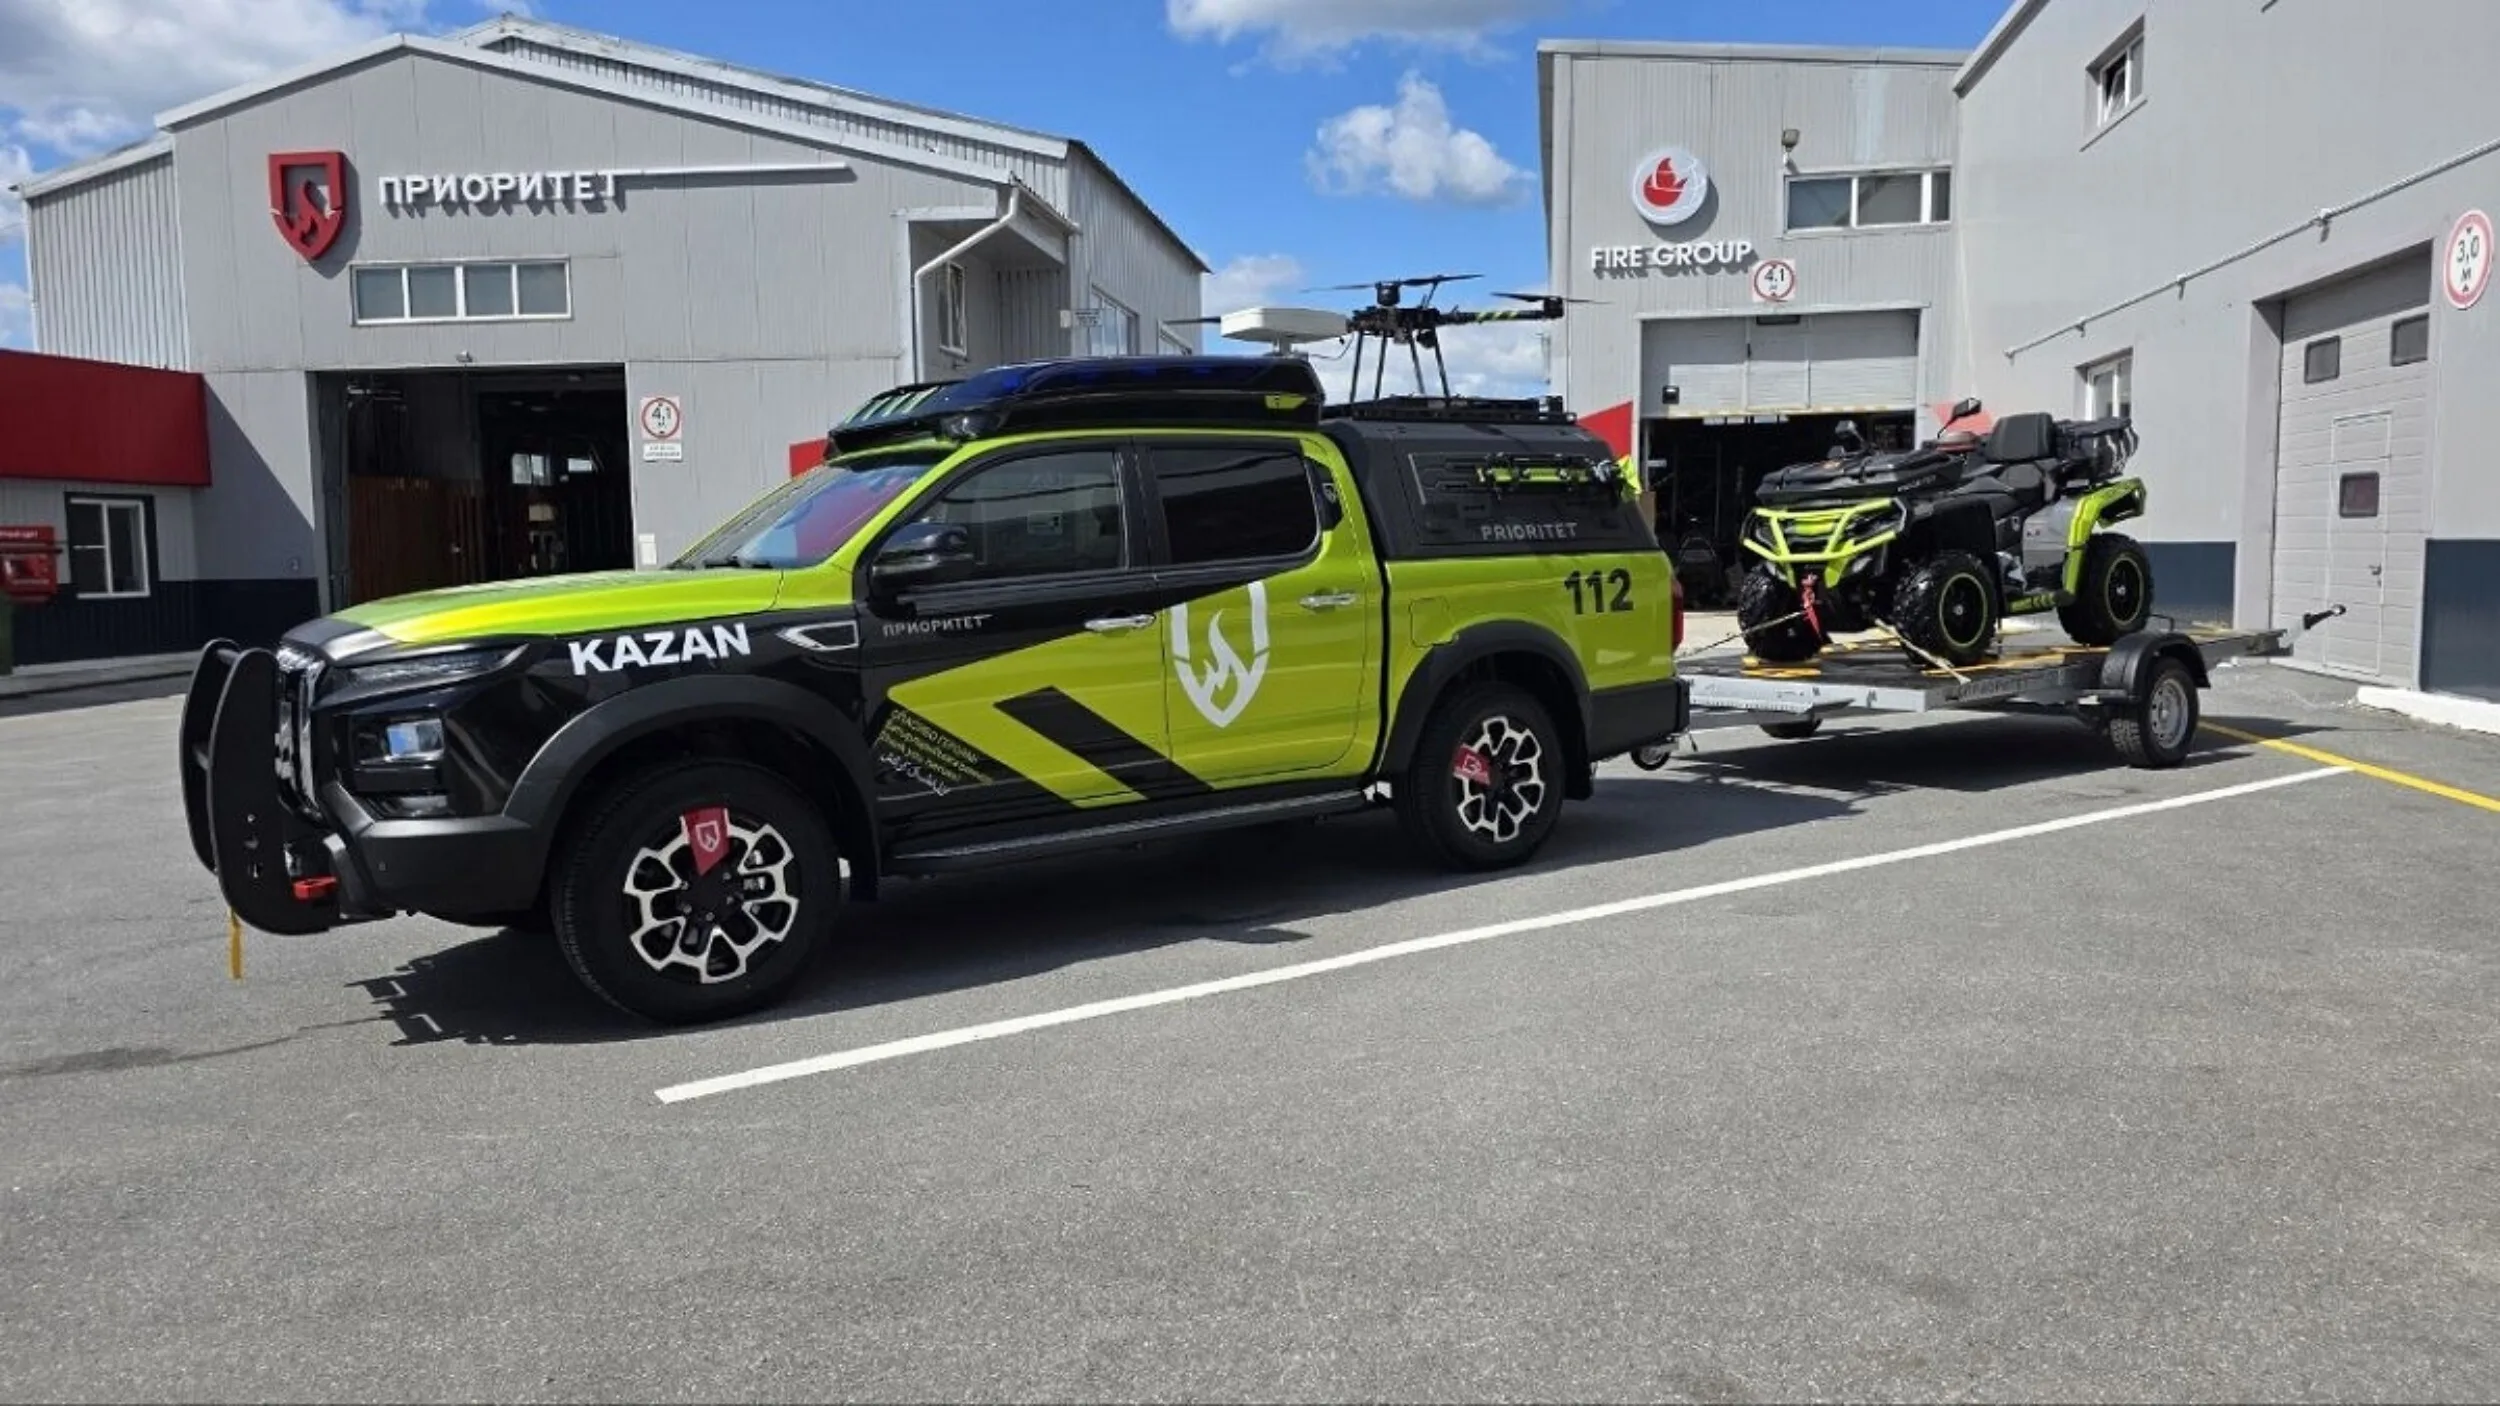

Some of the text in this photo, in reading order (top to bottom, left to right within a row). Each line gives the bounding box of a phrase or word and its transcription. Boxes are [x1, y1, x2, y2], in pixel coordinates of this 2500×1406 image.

[378, 166, 624, 205] ПРИОРИТЕТ
[1591, 241, 1751, 269] FIRE GROUP
[1480, 522, 1578, 541] PRIORITET
[1564, 568, 1634, 615] 112
[882, 614, 993, 637] ПРИОРИТЕТ
[567, 622, 751, 676] KAZAN
